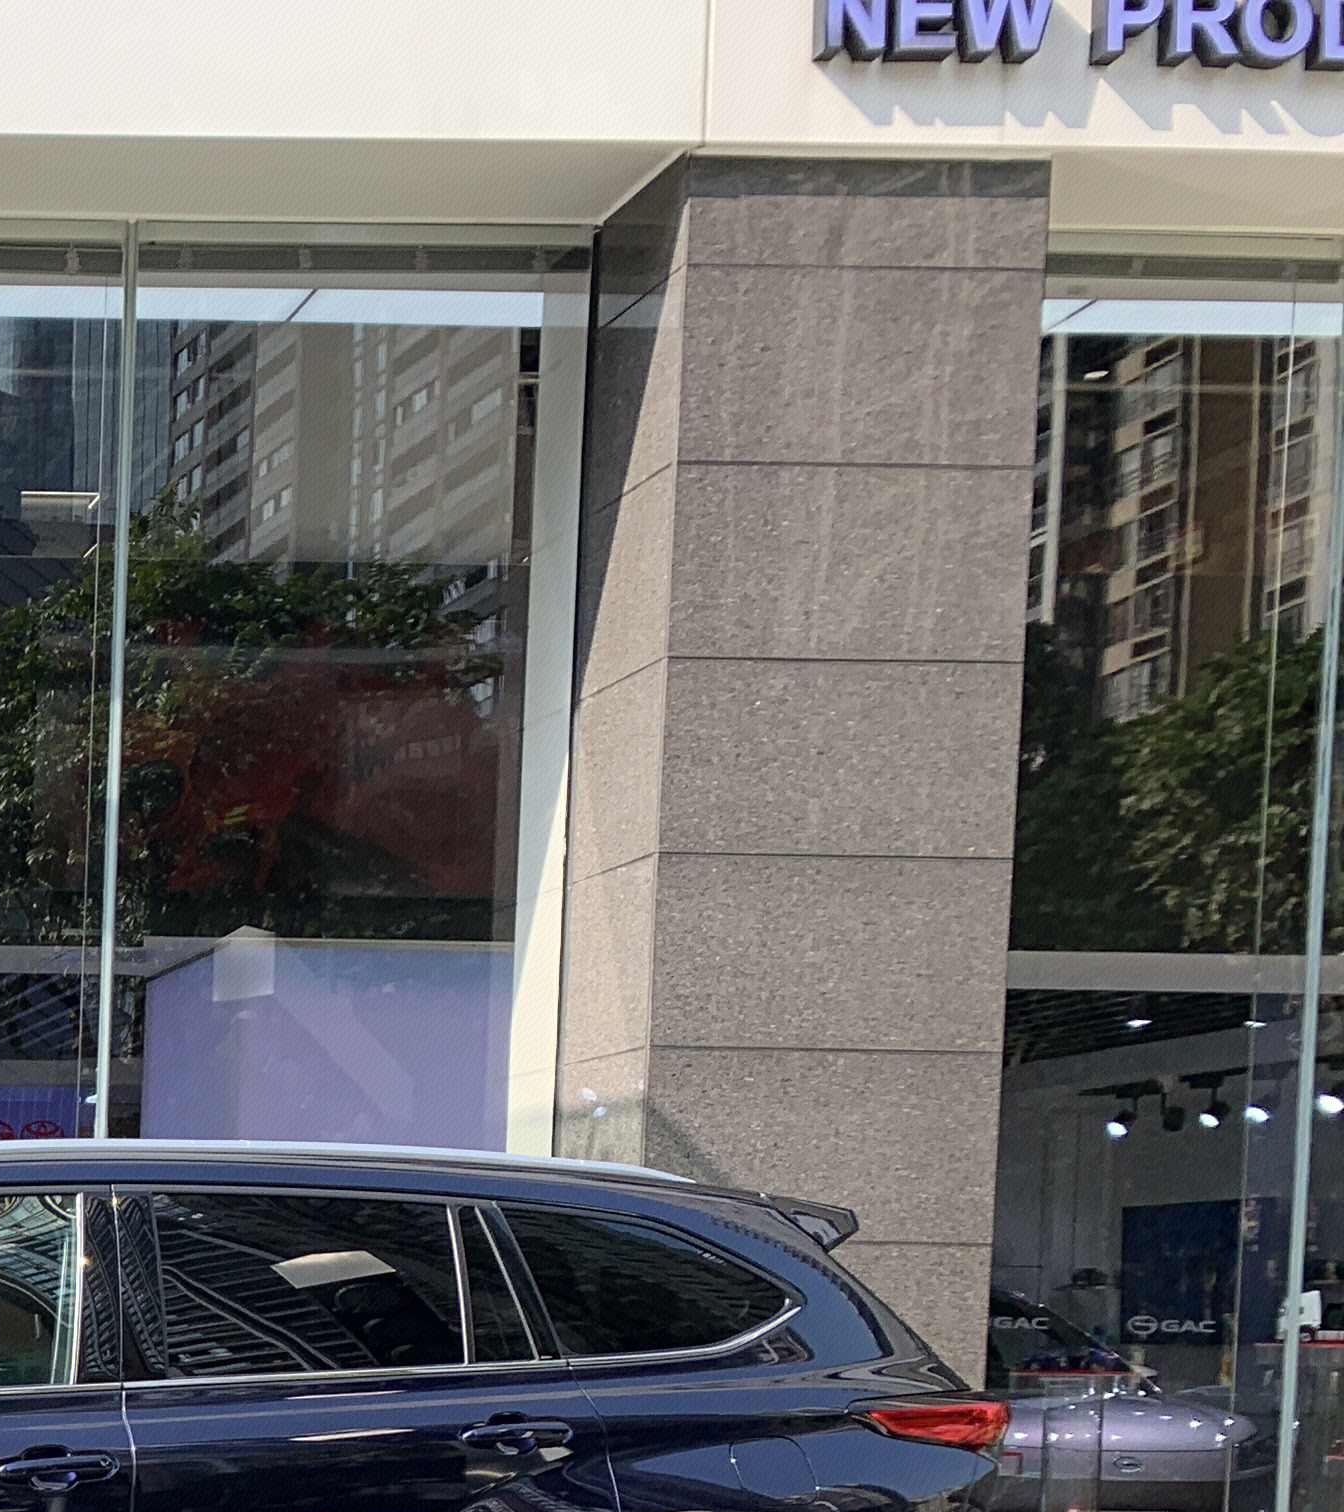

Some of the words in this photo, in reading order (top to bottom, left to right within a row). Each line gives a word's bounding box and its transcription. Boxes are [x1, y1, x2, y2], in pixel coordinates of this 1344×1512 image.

[815, 0, 1053, 61] NEW
[992, 1316, 1050, 1330] GAC
[1161, 1319, 1217, 1333] GAC
